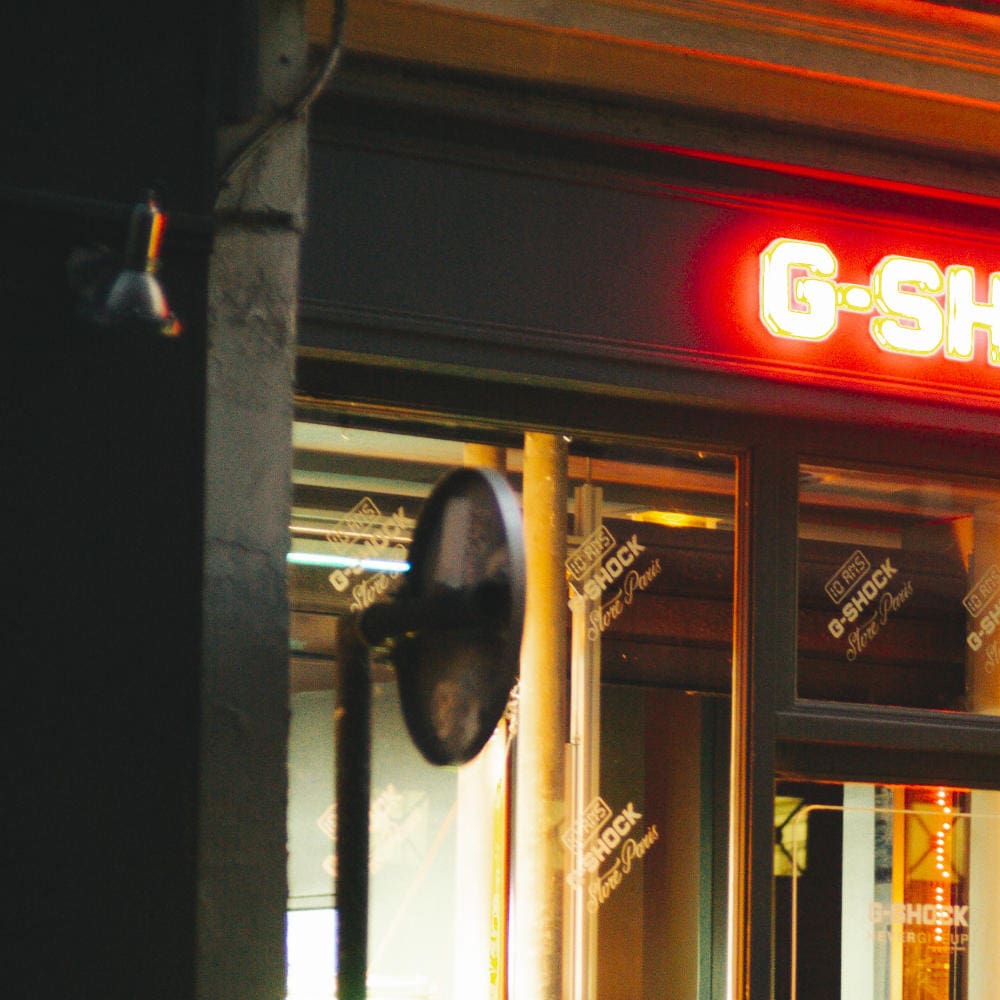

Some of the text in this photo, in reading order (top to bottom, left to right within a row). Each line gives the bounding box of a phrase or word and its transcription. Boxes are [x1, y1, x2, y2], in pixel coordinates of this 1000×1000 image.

[328, 506, 411, 592] G-HOCK
[827, 556, 898, 639] G-SHOCK
[846, 609, 880, 662] Store
[566, 801, 643, 891] GSHOCK
[868, 902, 969, 928] G-SHOCK
